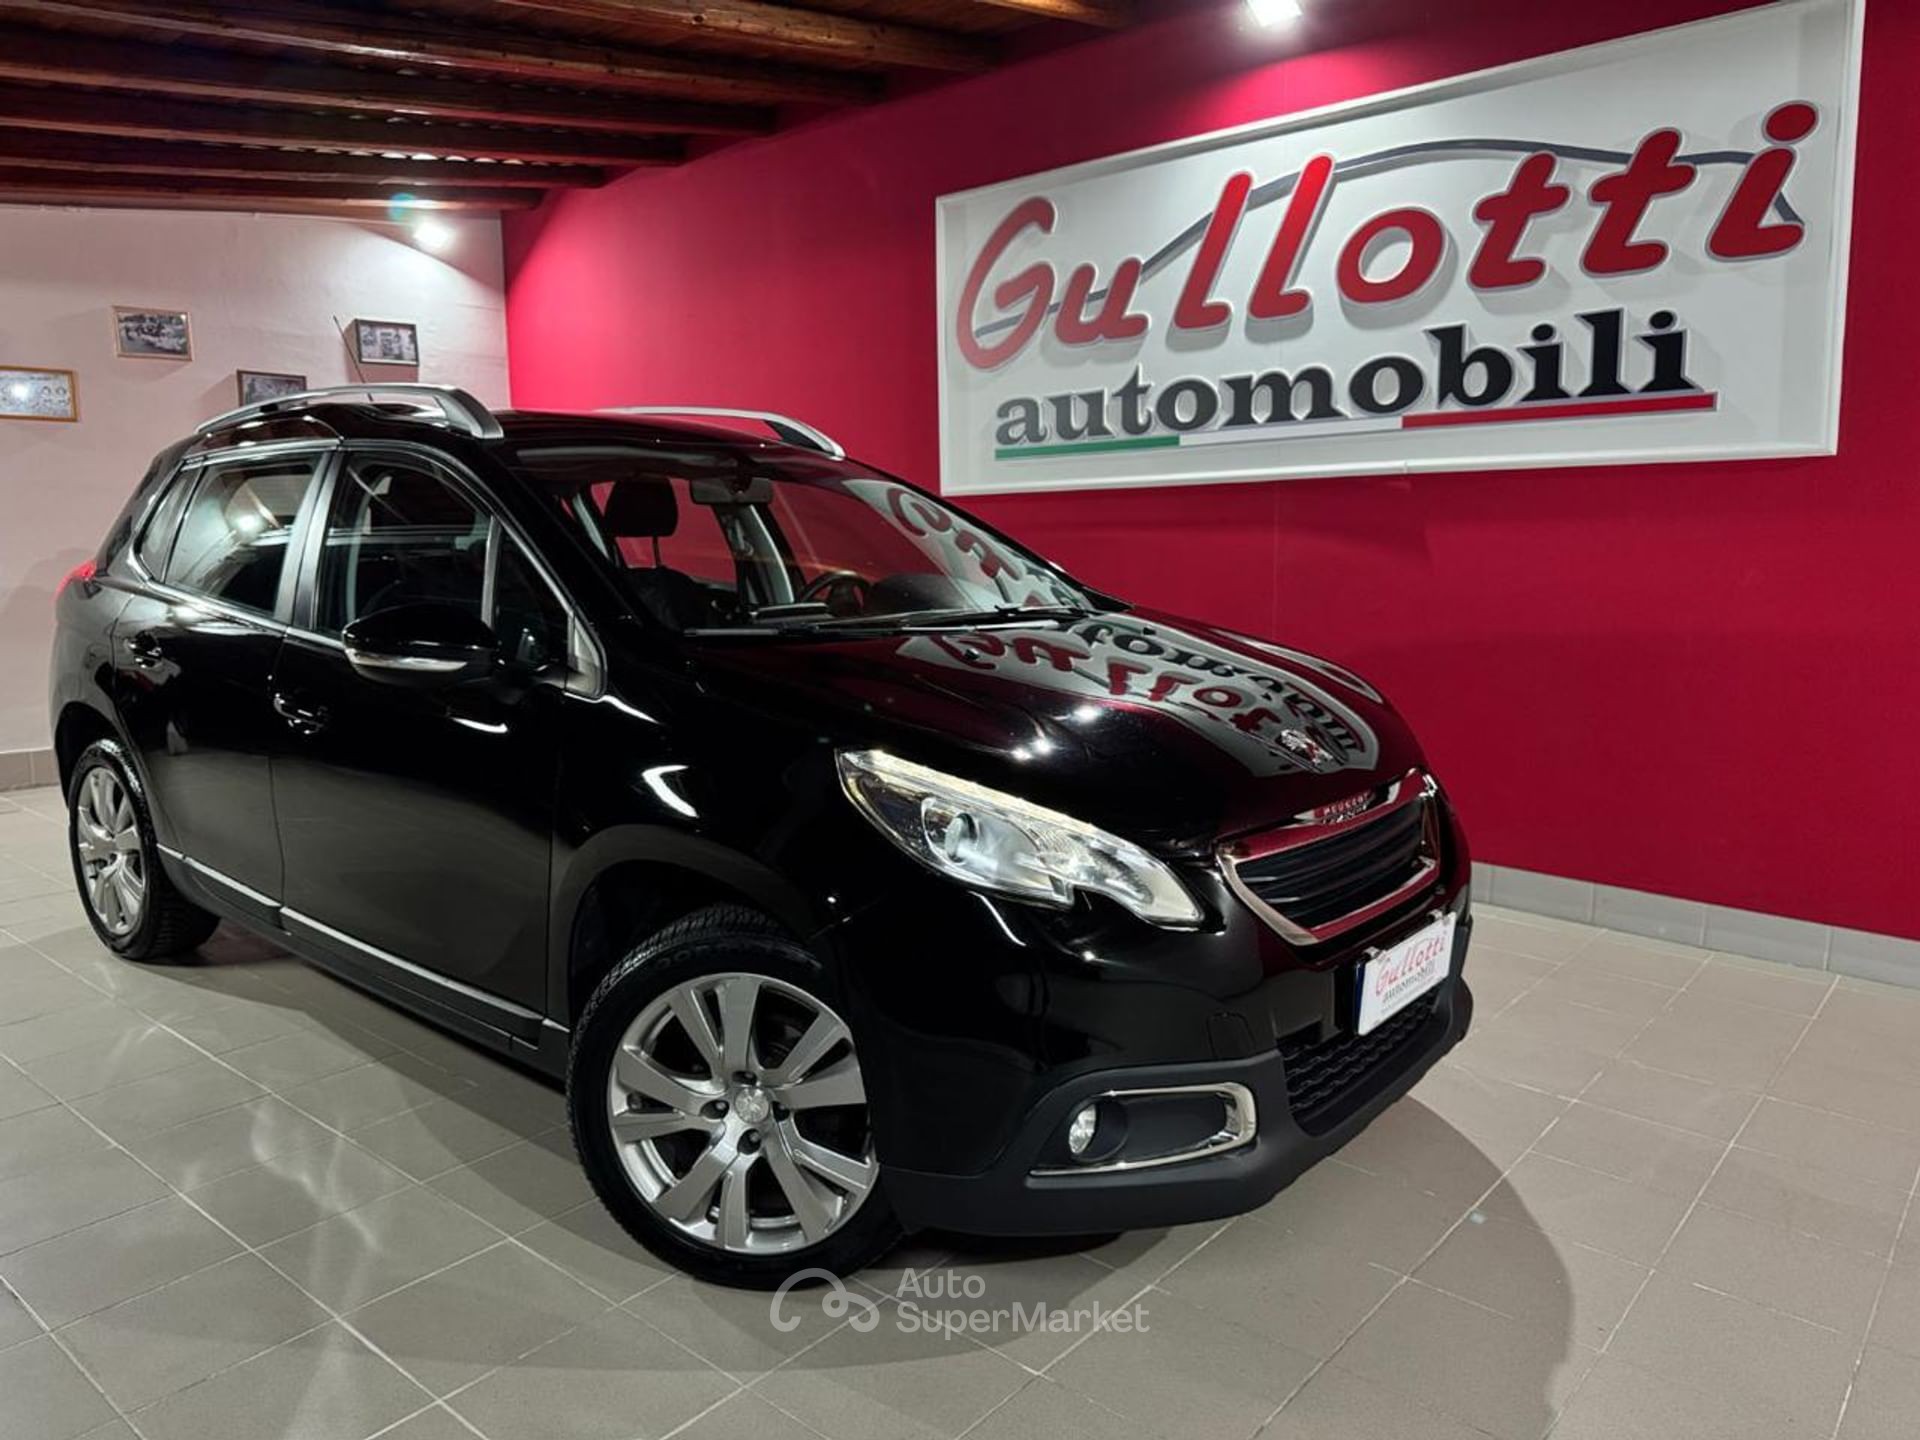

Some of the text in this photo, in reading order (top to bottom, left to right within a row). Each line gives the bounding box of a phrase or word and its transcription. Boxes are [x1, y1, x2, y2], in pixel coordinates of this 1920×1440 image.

[956, 100, 1819, 372] Gullotti
[994, 308, 1704, 448] automobili
[1375, 930, 1448, 998] Gullotti
